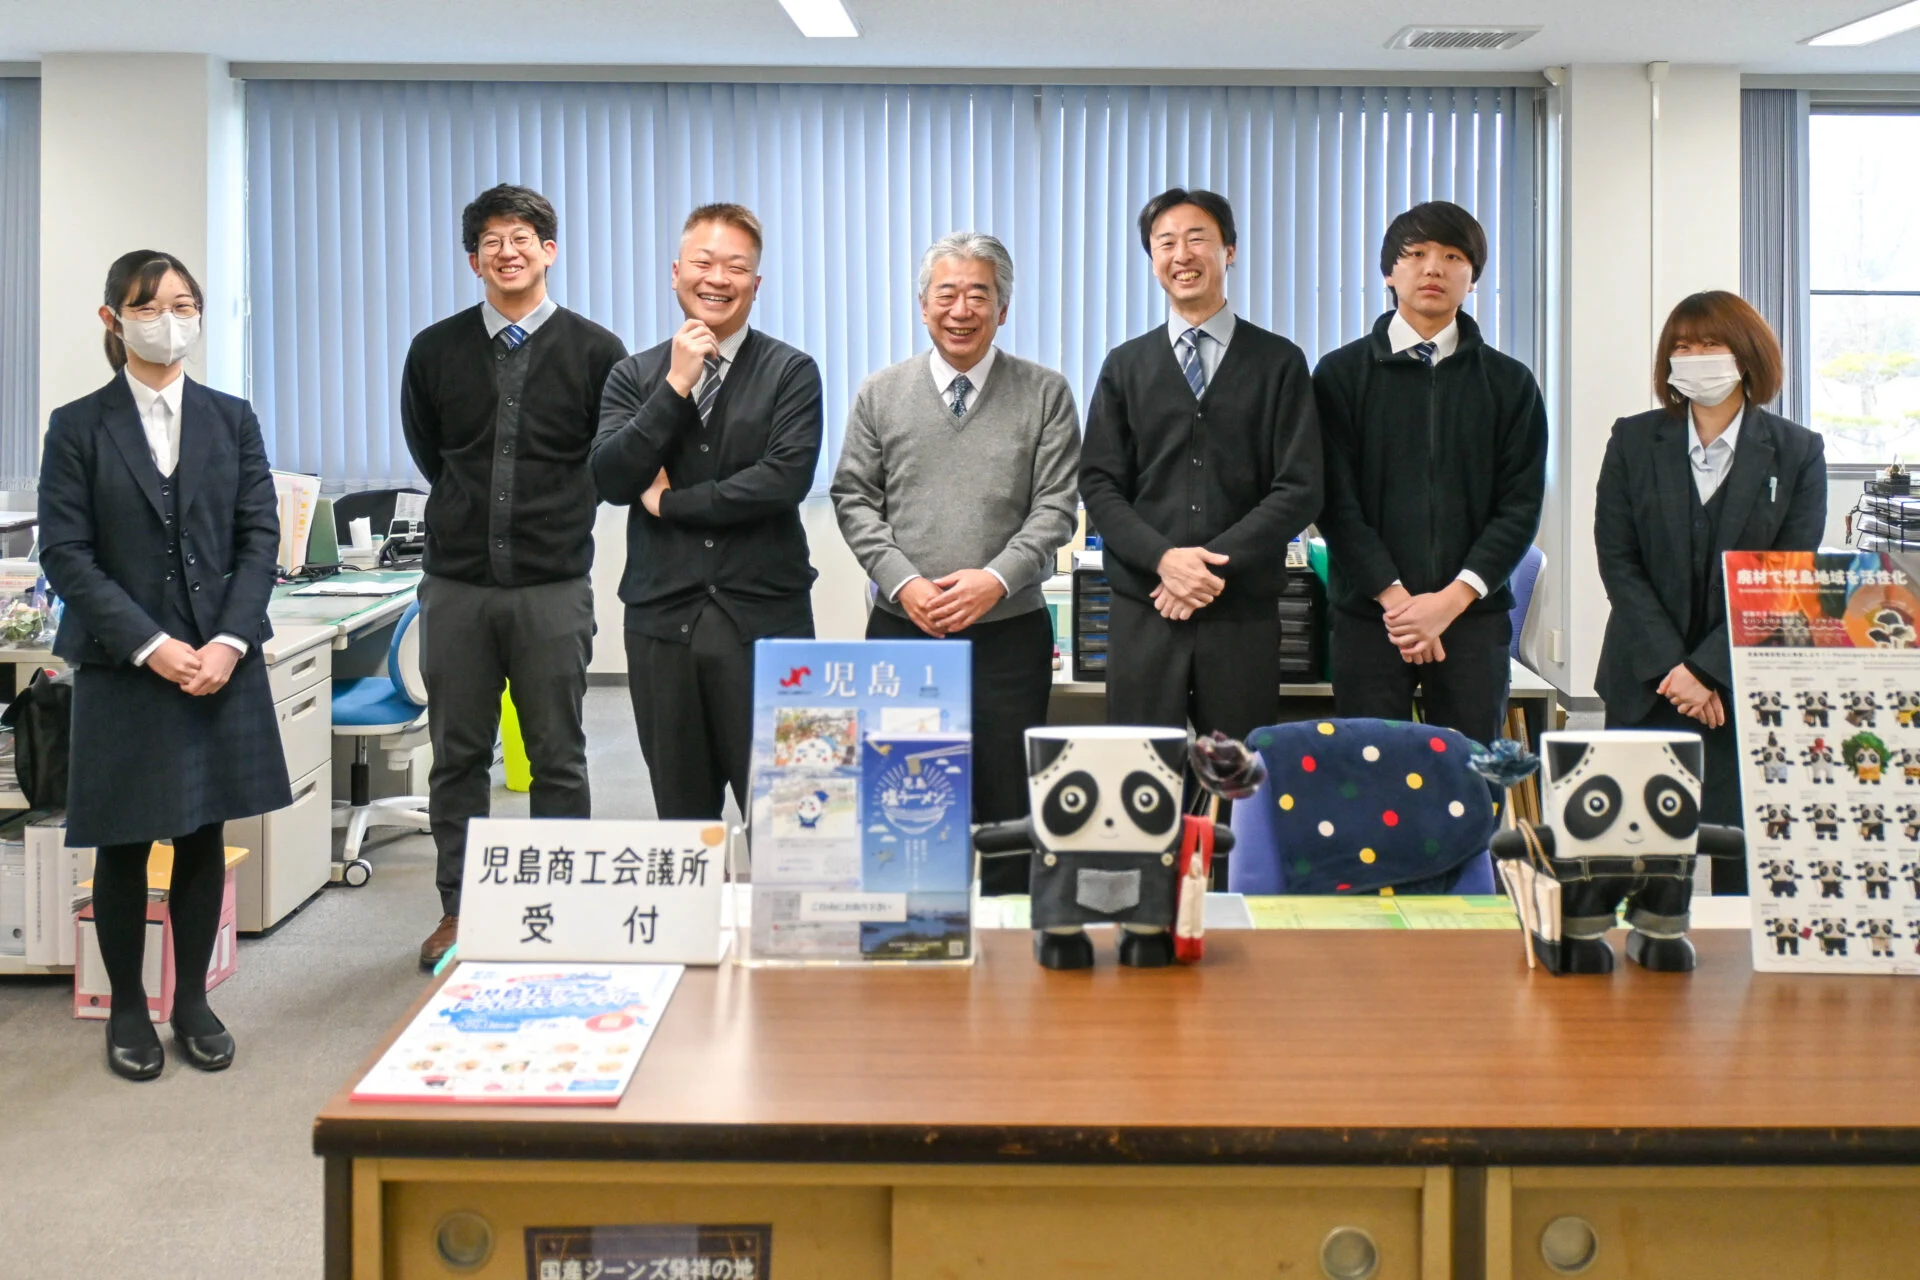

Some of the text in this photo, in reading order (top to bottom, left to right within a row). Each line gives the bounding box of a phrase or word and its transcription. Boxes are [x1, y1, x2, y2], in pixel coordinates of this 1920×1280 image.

[824, 661, 901, 698] 児島
[479, 846, 709, 887] 児島商工会議所
[540, 1258, 754, 1280] 国産ジーンズ発祥の地
